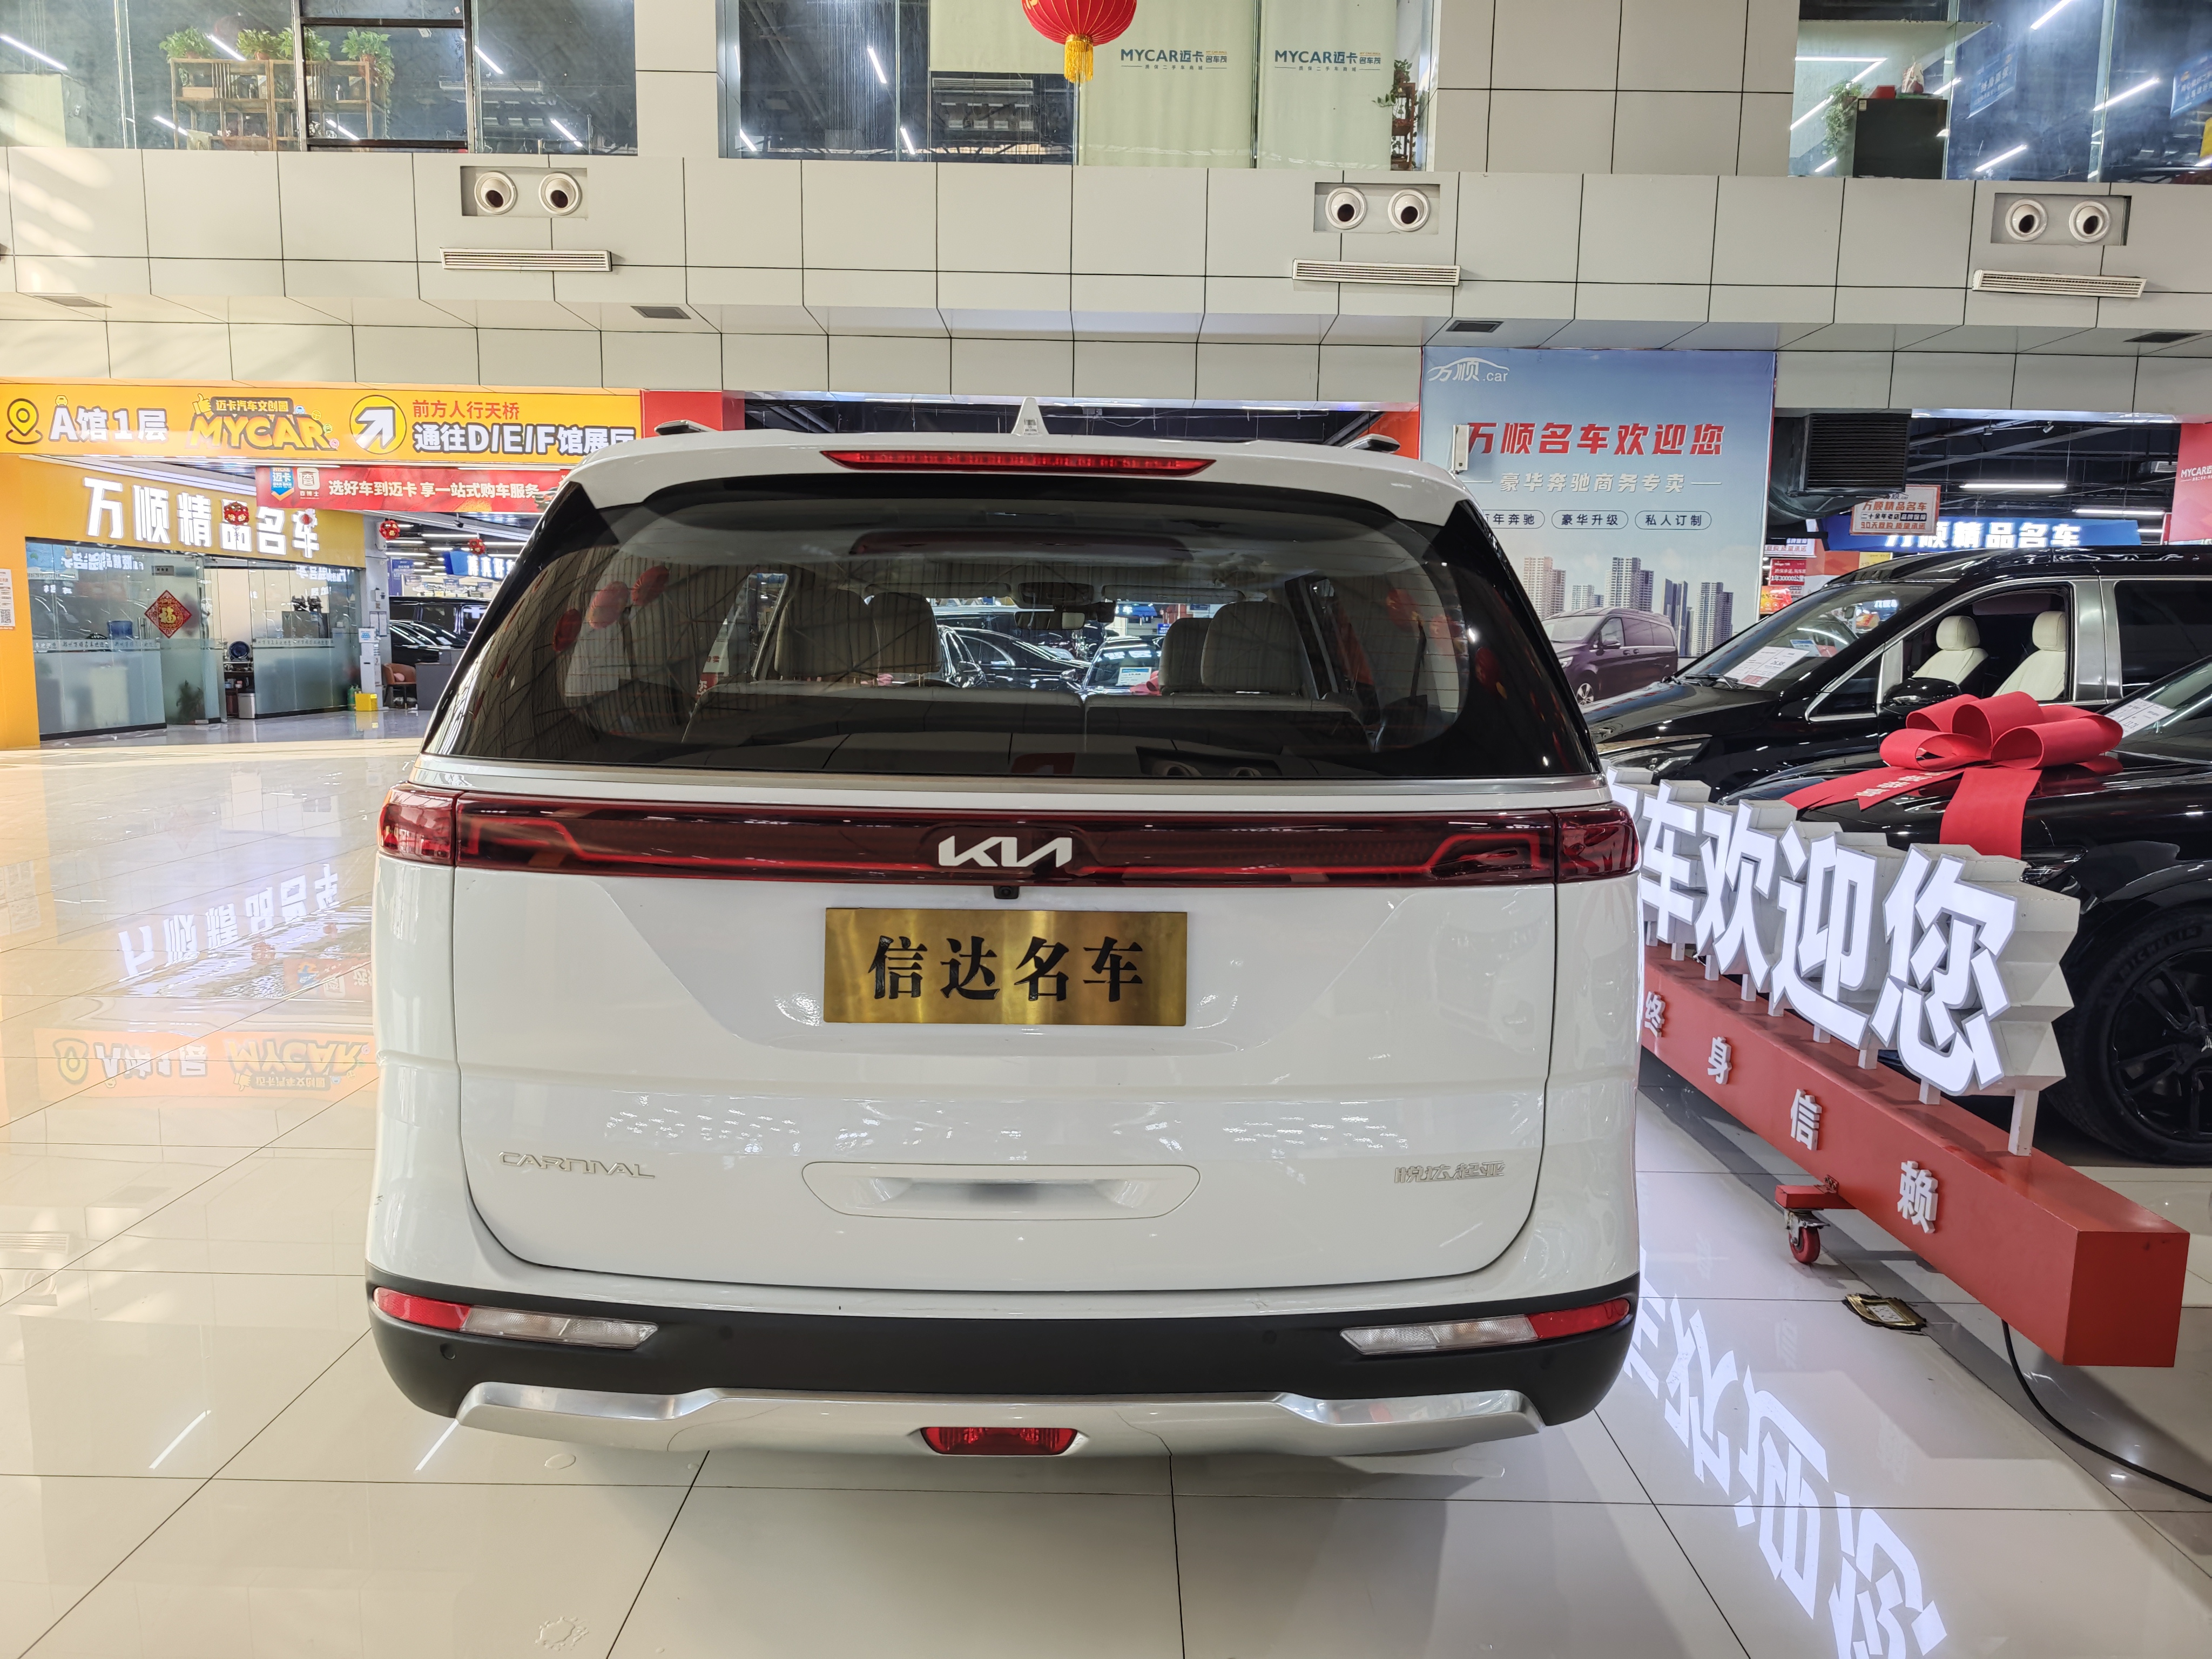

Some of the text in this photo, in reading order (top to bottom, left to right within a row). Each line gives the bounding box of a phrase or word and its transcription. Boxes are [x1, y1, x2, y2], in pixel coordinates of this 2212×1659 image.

[216, 400, 289, 412] 迈卡汽车文创园
[413, 400, 520, 420] 前方人行天桥
[49, 406, 168, 442] A馆1层
[188, 414, 335, 450] MYCAR
[1467, 422, 1725, 456] 万顺名车欢迎您
[272, 471, 292, 482] 迈卡
[1500, 472, 1685, 493] 豪华奔驰商务专卖
[328, 480, 540, 500] 选好车到迈卡 享一站式购车服务
[1863, 501, 1928, 511] 万顺精品名车
[83, 477, 320, 558] 万顺精品名车
[1561, 513, 1618, 527] 豪华升级
[1645, 514, 1702, 527] 私人订制
[158, 606, 177, 624] 福
[938, 835, 1073, 868] KIA
[1607, 767, 2018, 1095] 车欢迎您
[868, 935, 1143, 1003] 信达名车
[498, 1151, 655, 1179] CARNIVAL
[1394, 1161, 1506, 1183] 悦达起亚
